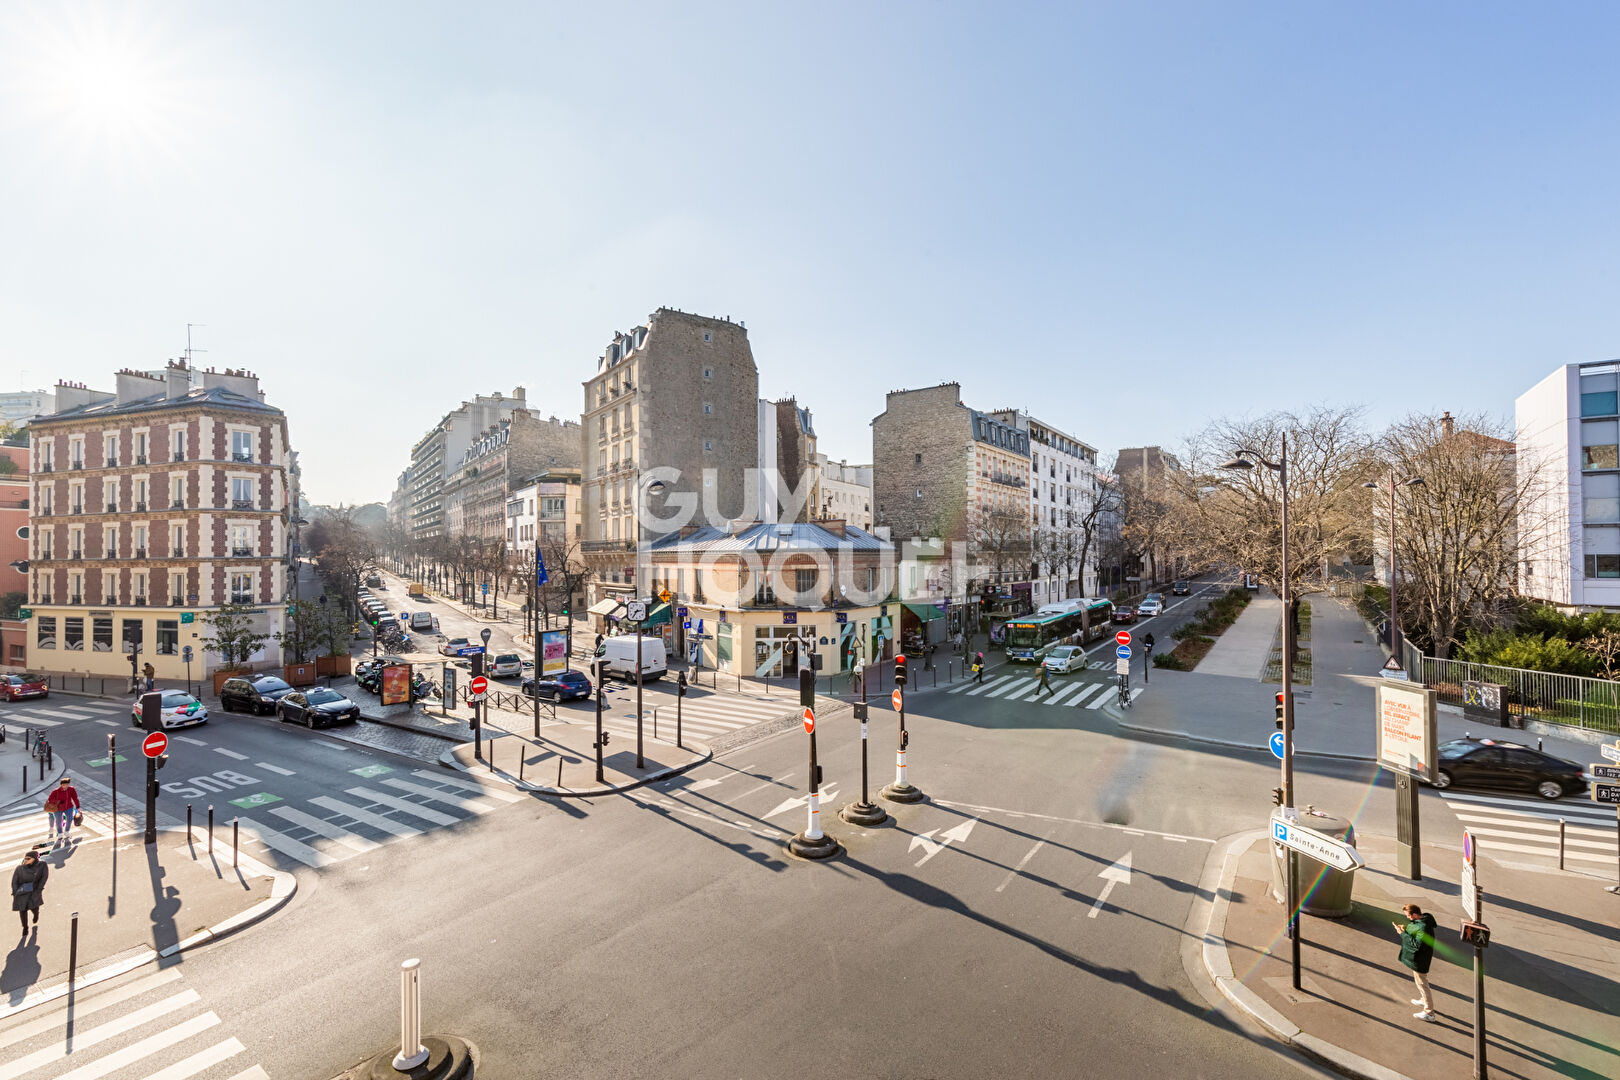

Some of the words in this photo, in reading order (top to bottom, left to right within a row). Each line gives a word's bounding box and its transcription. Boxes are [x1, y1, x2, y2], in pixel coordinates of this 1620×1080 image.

[1087, 661, 1126, 671] BU
[160, 769, 262, 798] BUS
[1289, 833, 1340, 861] Sainte-Anne
